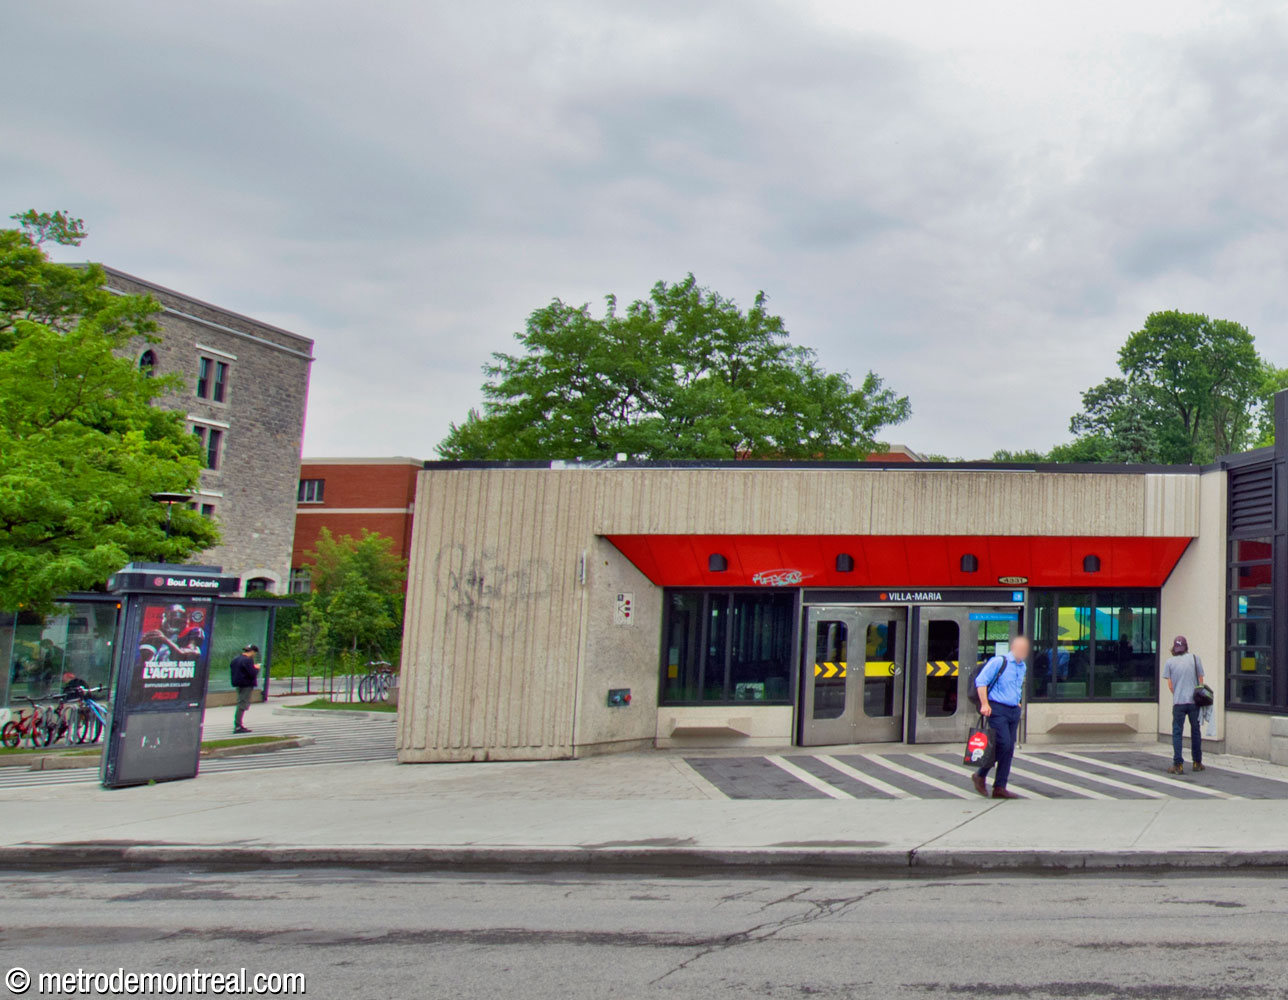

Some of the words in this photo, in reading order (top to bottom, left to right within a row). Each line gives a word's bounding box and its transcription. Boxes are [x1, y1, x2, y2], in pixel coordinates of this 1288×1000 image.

[167, 578, 187, 586] Boul.
[189, 579, 218, 588] Décarie
[143, 667, 195, 679] L'ACTION
